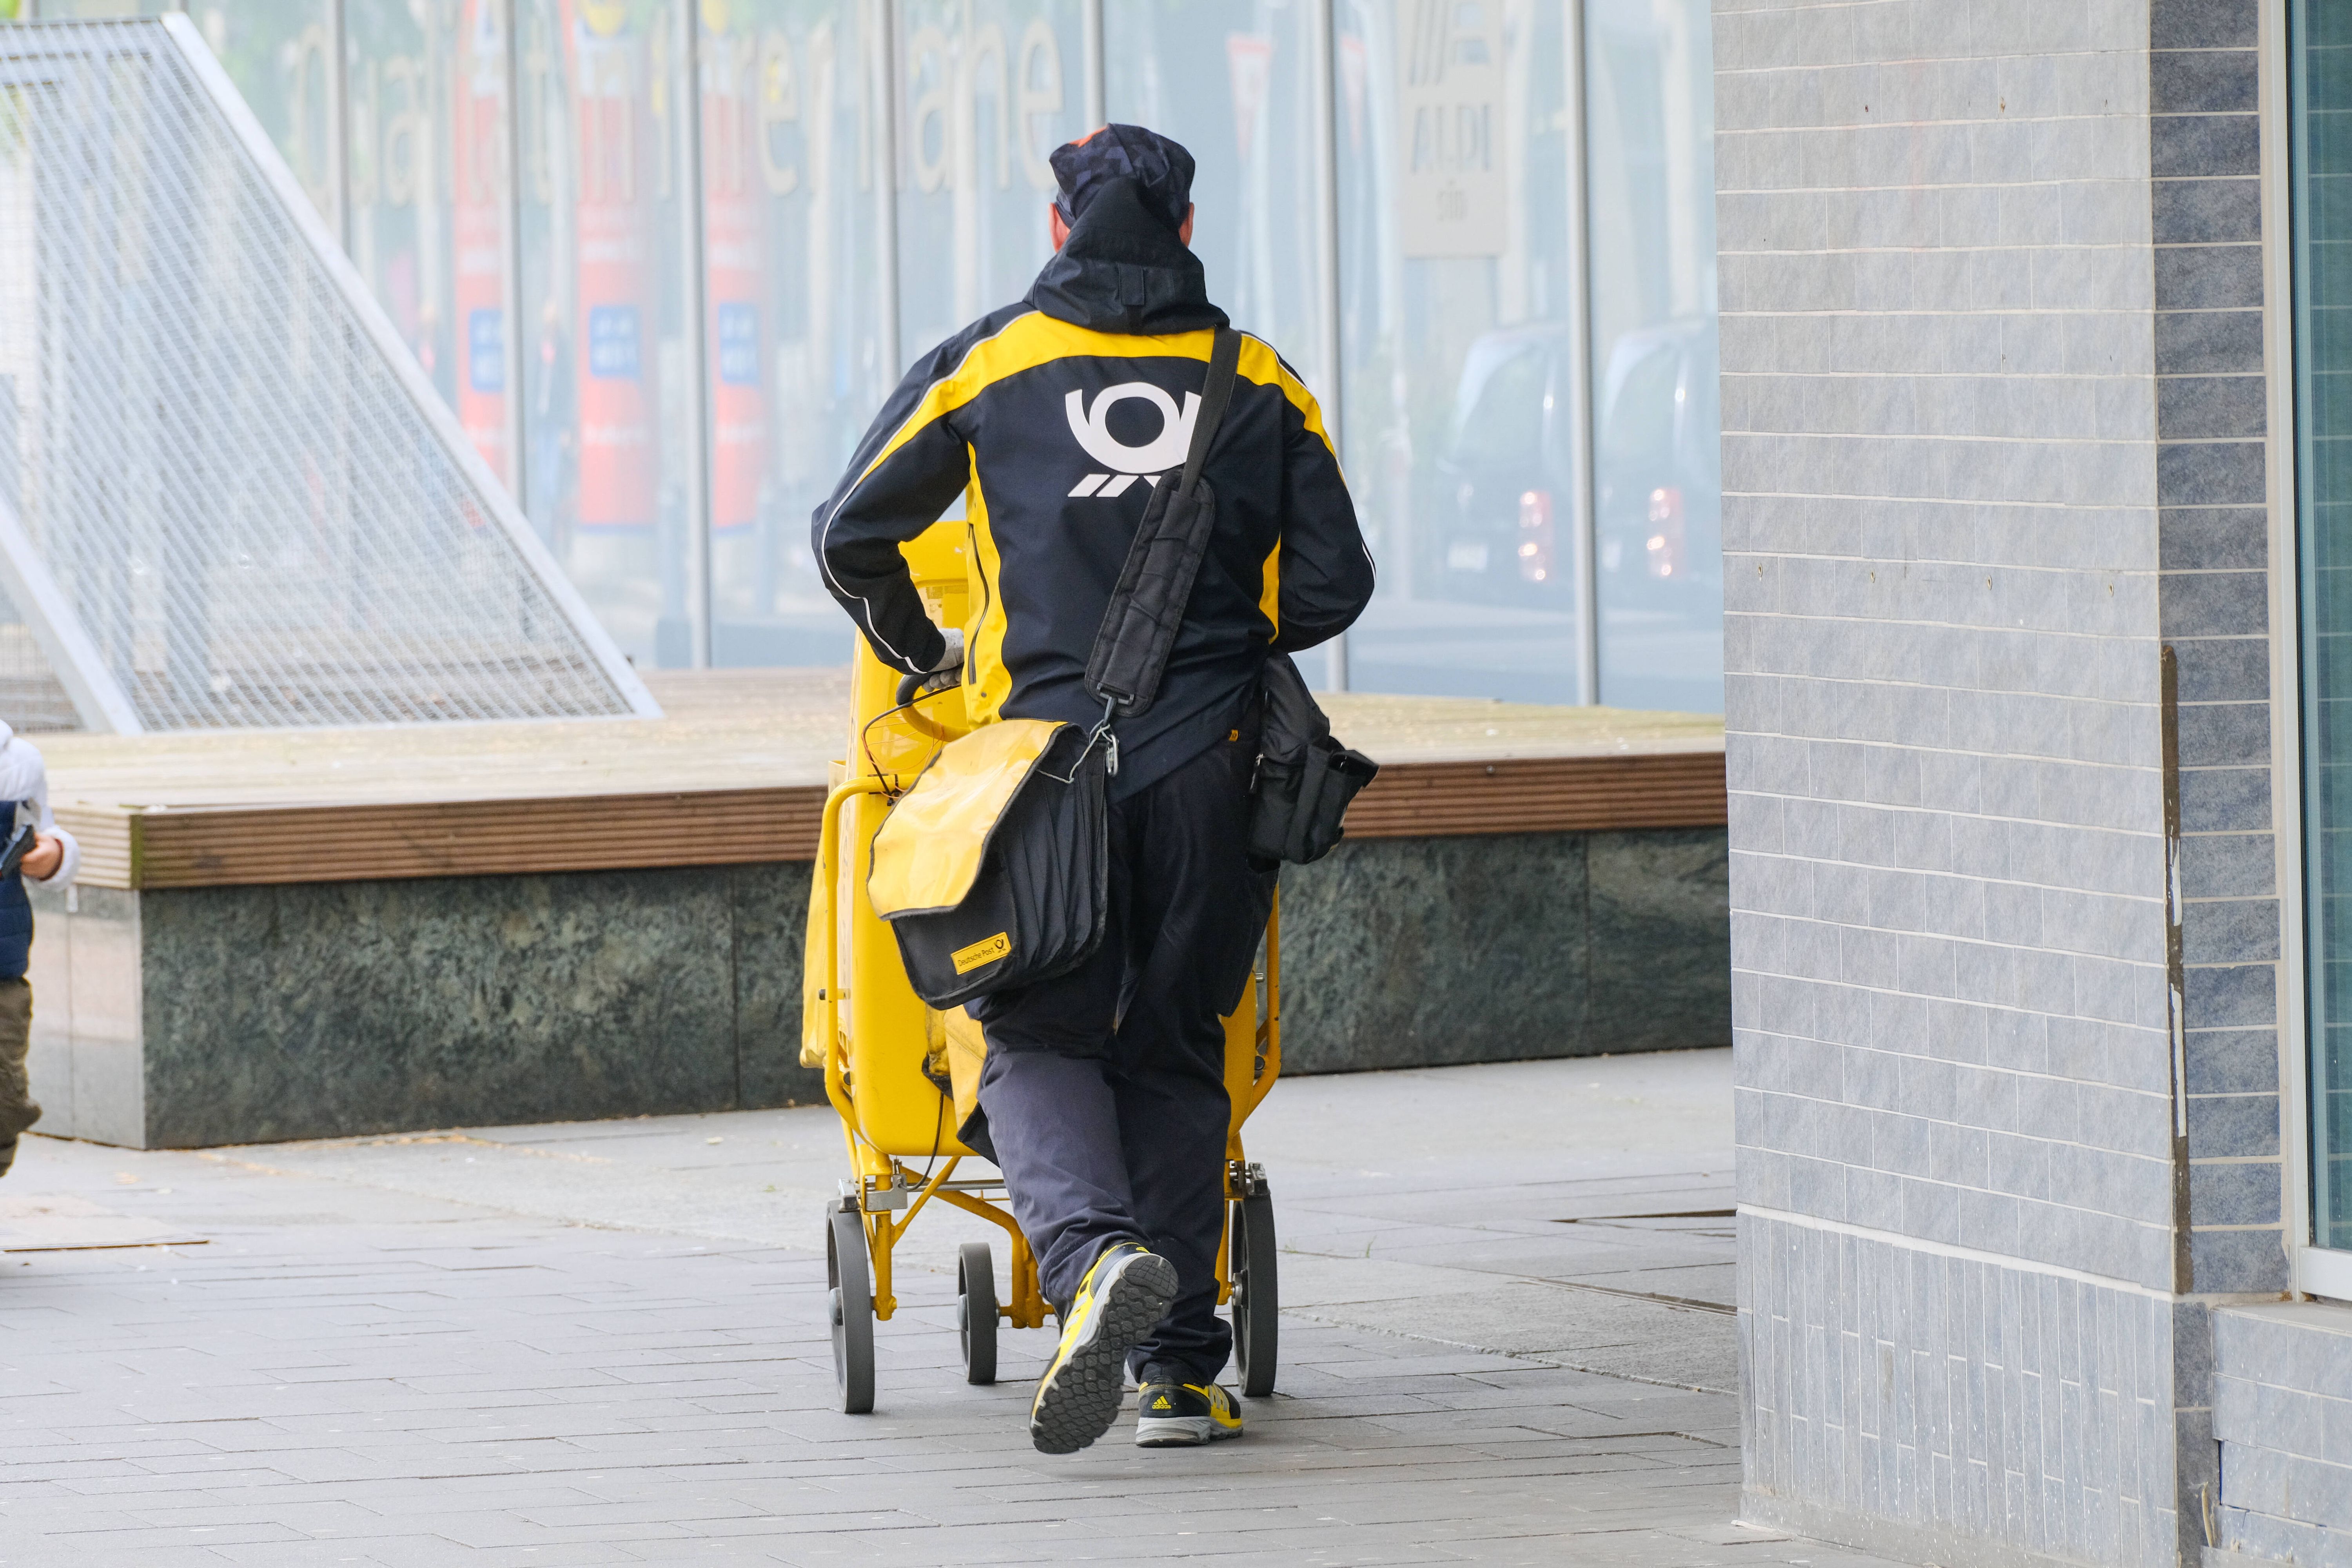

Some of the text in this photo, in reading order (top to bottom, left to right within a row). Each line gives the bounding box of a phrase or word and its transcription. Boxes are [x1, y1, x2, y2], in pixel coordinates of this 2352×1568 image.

[1409, 103, 1491, 173] ALDI
[958, 948, 995, 966] Deutsche Post
